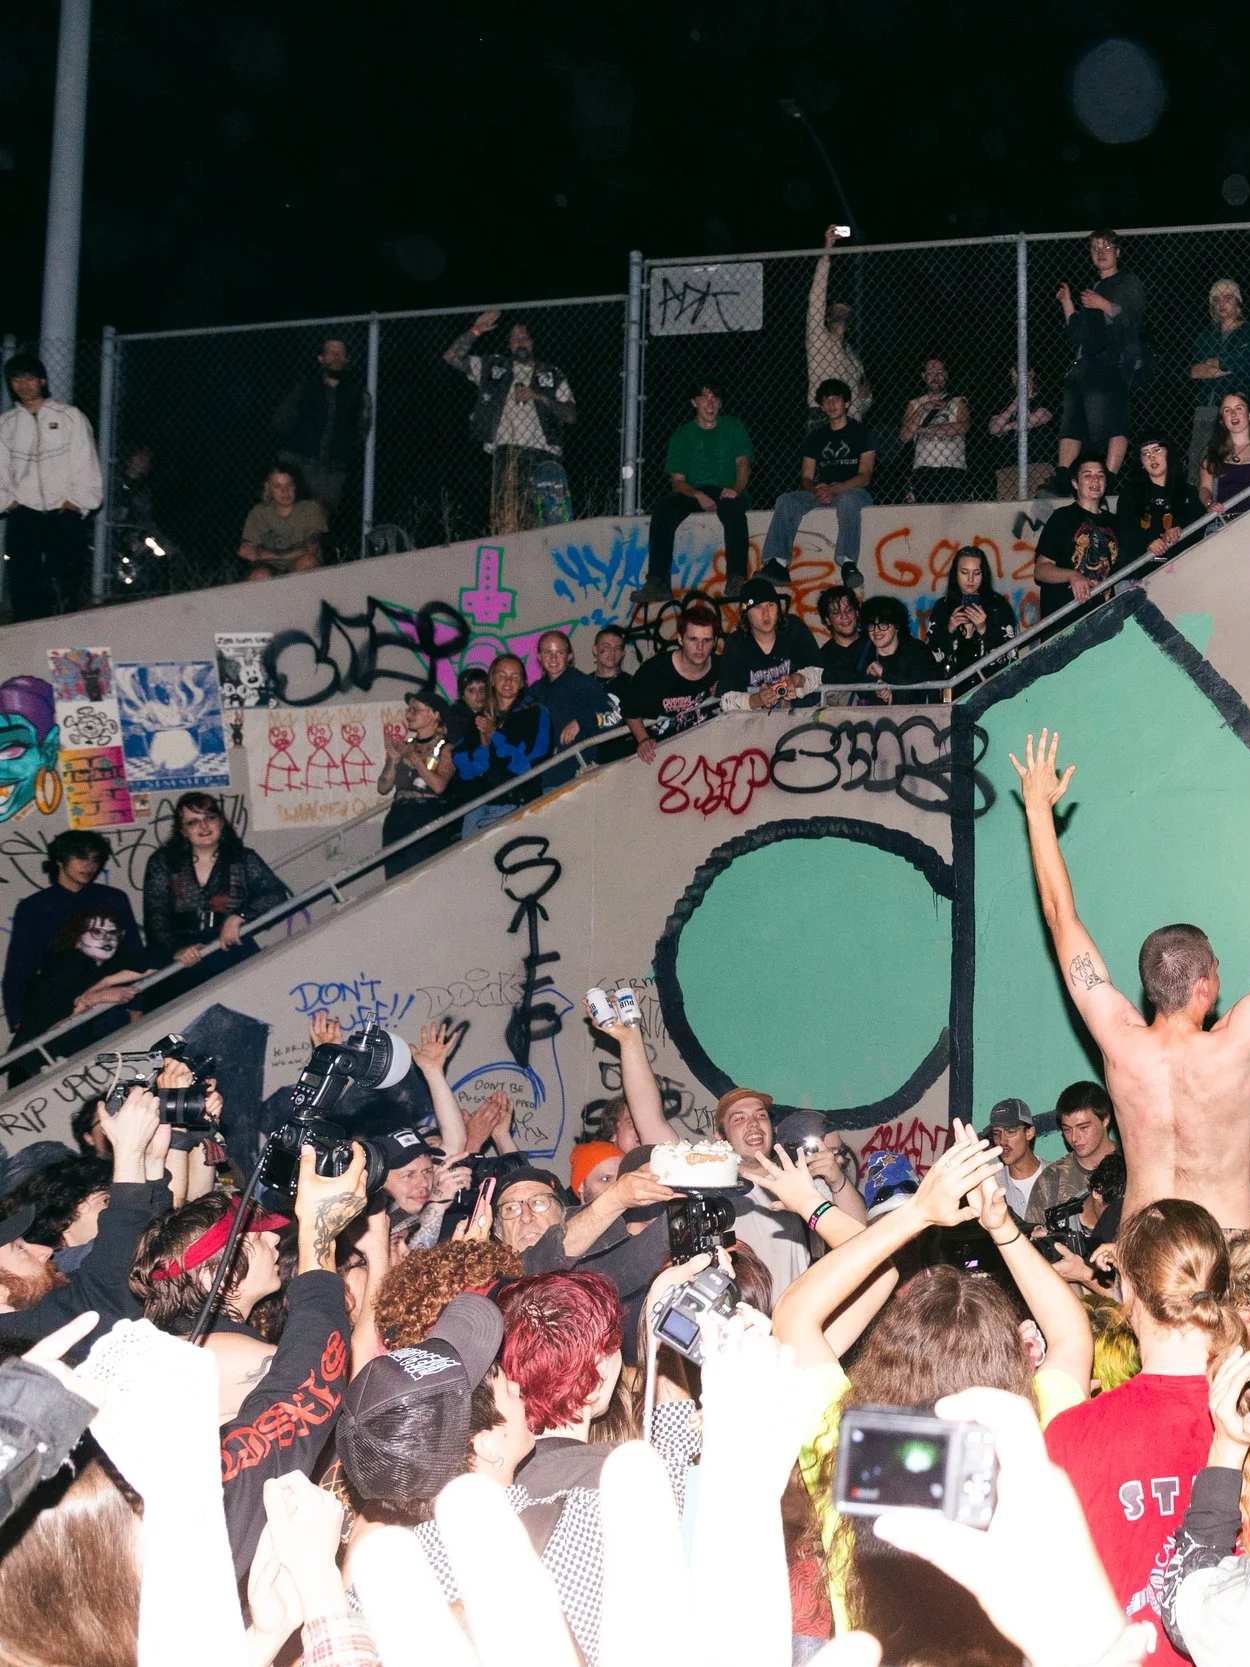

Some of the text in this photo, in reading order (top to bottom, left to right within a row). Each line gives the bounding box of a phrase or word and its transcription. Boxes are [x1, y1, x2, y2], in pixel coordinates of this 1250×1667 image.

[289, 971, 381, 1013] DON'T
[509, 1082, 525, 1094] BE
[0, 1097, 48, 1135] RIP
